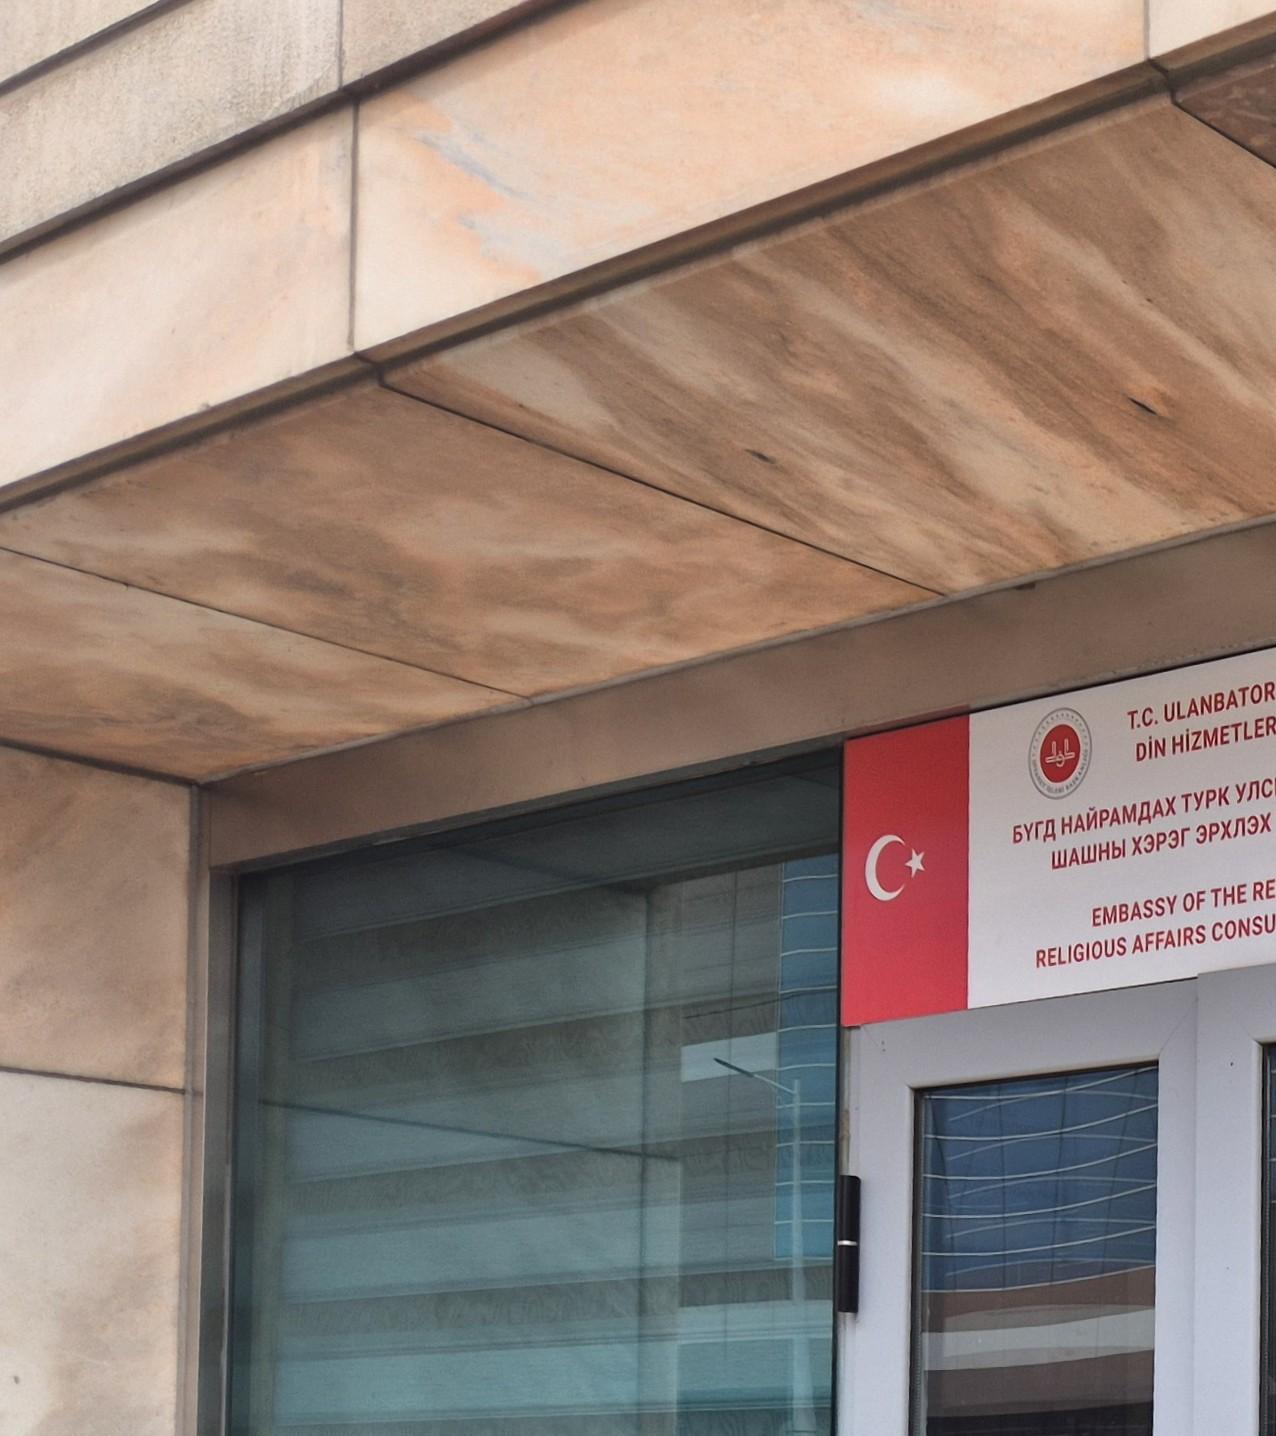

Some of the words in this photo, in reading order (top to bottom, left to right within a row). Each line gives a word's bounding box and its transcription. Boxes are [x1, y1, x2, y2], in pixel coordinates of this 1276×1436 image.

[1128, 707, 1158, 729] T.C.
[1164, 682, 1275, 722] ULANBATOR
[1136, 735, 1166, 761] DİN
[1012, 819, 1056, 844] БҮГД
[1061, 796, 1176, 835] НАЙРАМДАХ
[1181, 786, 1229, 812] ТУРК
[1051, 840, 1126, 869] ШАШНЫ
[1132, 827, 1190, 855] ХЭРЭГ
[1196, 813, 1272, 844] ЭРХЛЭХ
[1092, 895, 1178, 927] EMBASSY
[1183, 891, 1206, 912] OF
[1211, 884, 1247, 907] THE
[1036, 937, 1127, 968] RELIGIOUS
[1132, 925, 1206, 954] AFFAIRS
